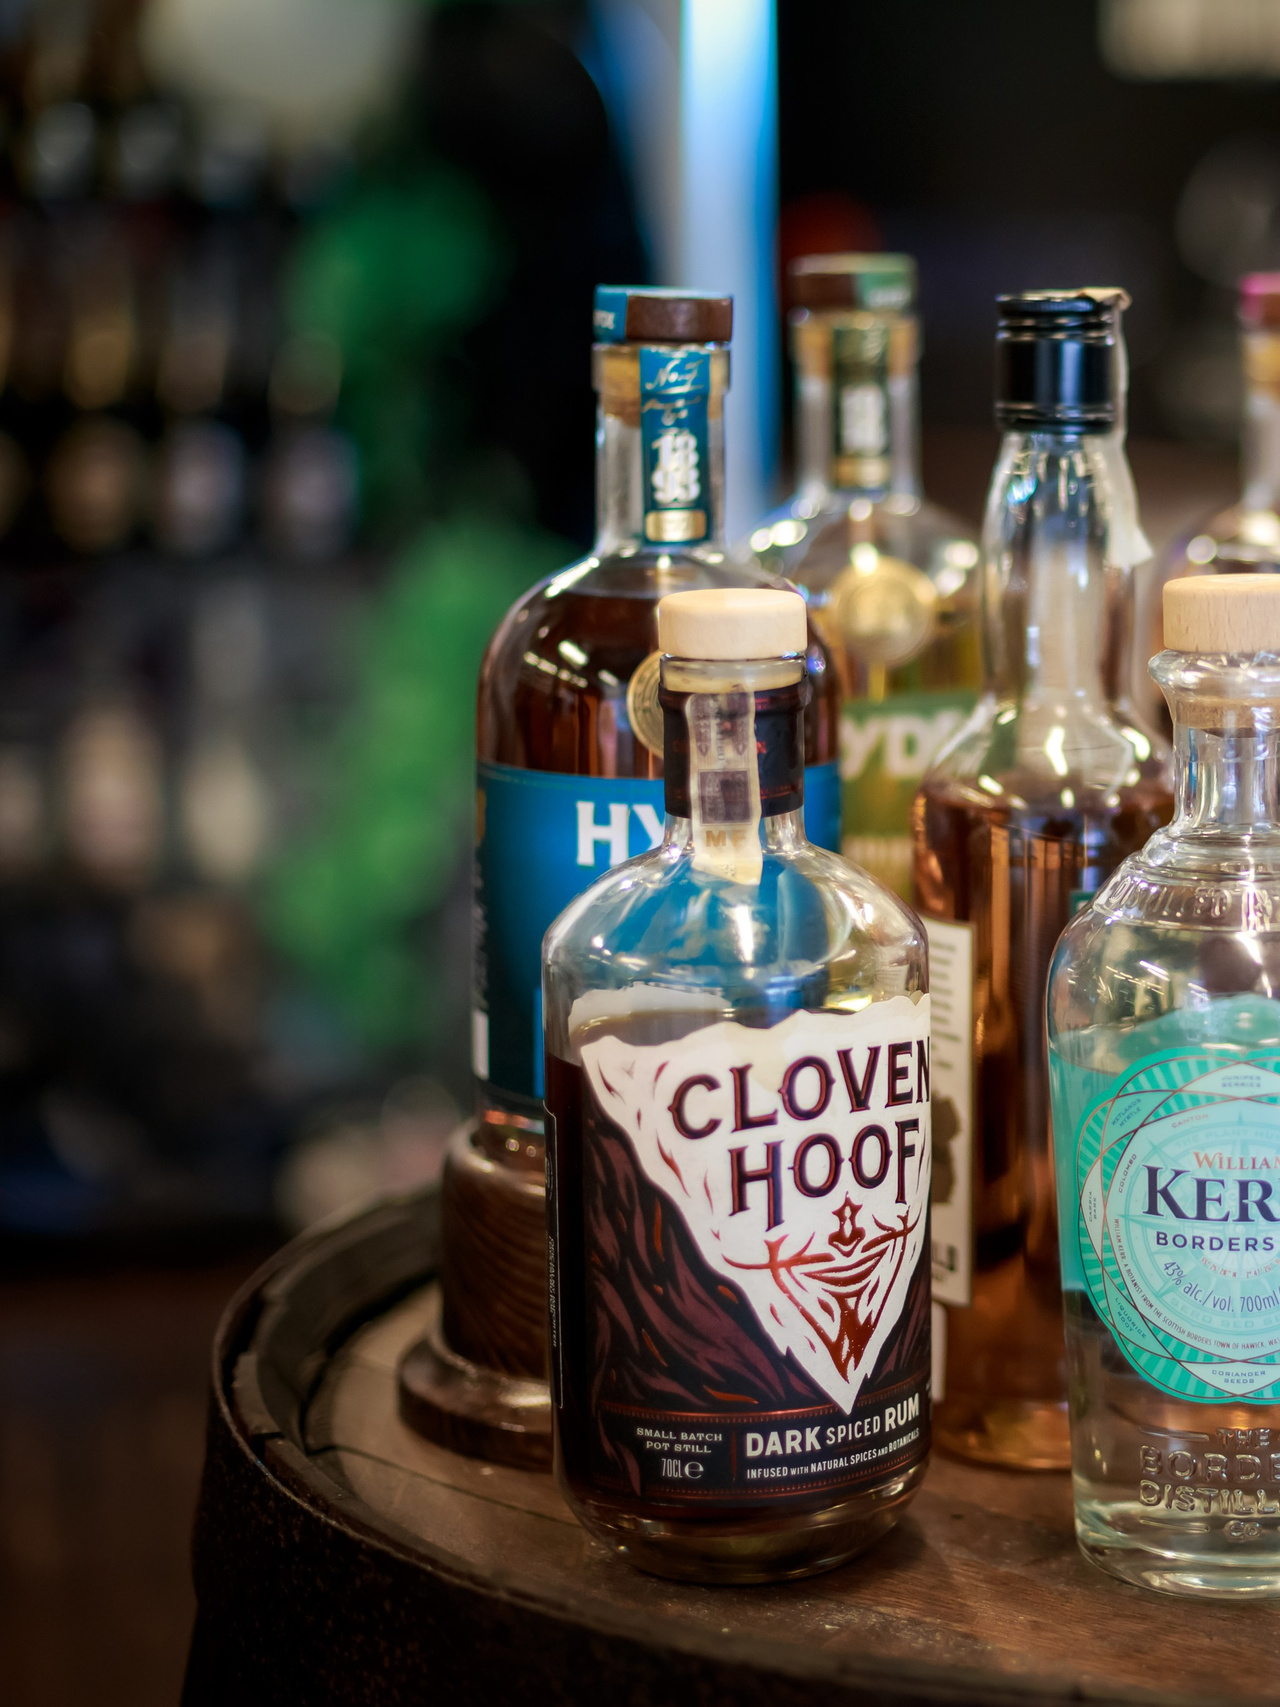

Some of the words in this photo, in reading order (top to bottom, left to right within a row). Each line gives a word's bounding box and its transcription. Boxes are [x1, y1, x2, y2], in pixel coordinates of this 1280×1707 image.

[668, 1036, 930, 1140] CLOVEN
[728, 1118, 920, 1232] HOOF
[1156, 1230, 1275, 1252] BORDERS
[1163, 1261, 1188, 1286] 43%
[1141, 1294, 1154, 1310] FROM
[1153, 1307, 1163, 1318] THE
[1162, 1315, 1187, 1335] SCOTTISH
[1186, 1331, 1212, 1346] BORDERS
[1214, 1340, 1231, 1349] TOWN
[1268, 1338, 1280, 1347] WAS
[1211, 1369, 1266, 1377] CORIANDER
[636, 1427, 677, 1441] SMALL
[680, 1431, 723, 1442] BATCH
[745, 1426, 822, 1457] DARK
[825, 1414, 882, 1445] SPICED
[884, 1393, 920, 1433] RUM
[646, 1441, 671, 1451] POT
[674, 1443, 712, 1454] STILL
[1215, 1428, 1271, 1449] THE
[746, 1465, 788, 1480] INFUSED
[790, 1464, 809, 1476] WITH
[810, 1455, 849, 1474] NATURAL
[850, 1449, 877, 1465] SPICES
[878, 1446, 889, 1457] AND
[888, 1427, 920, 1454] BOTANICALS
